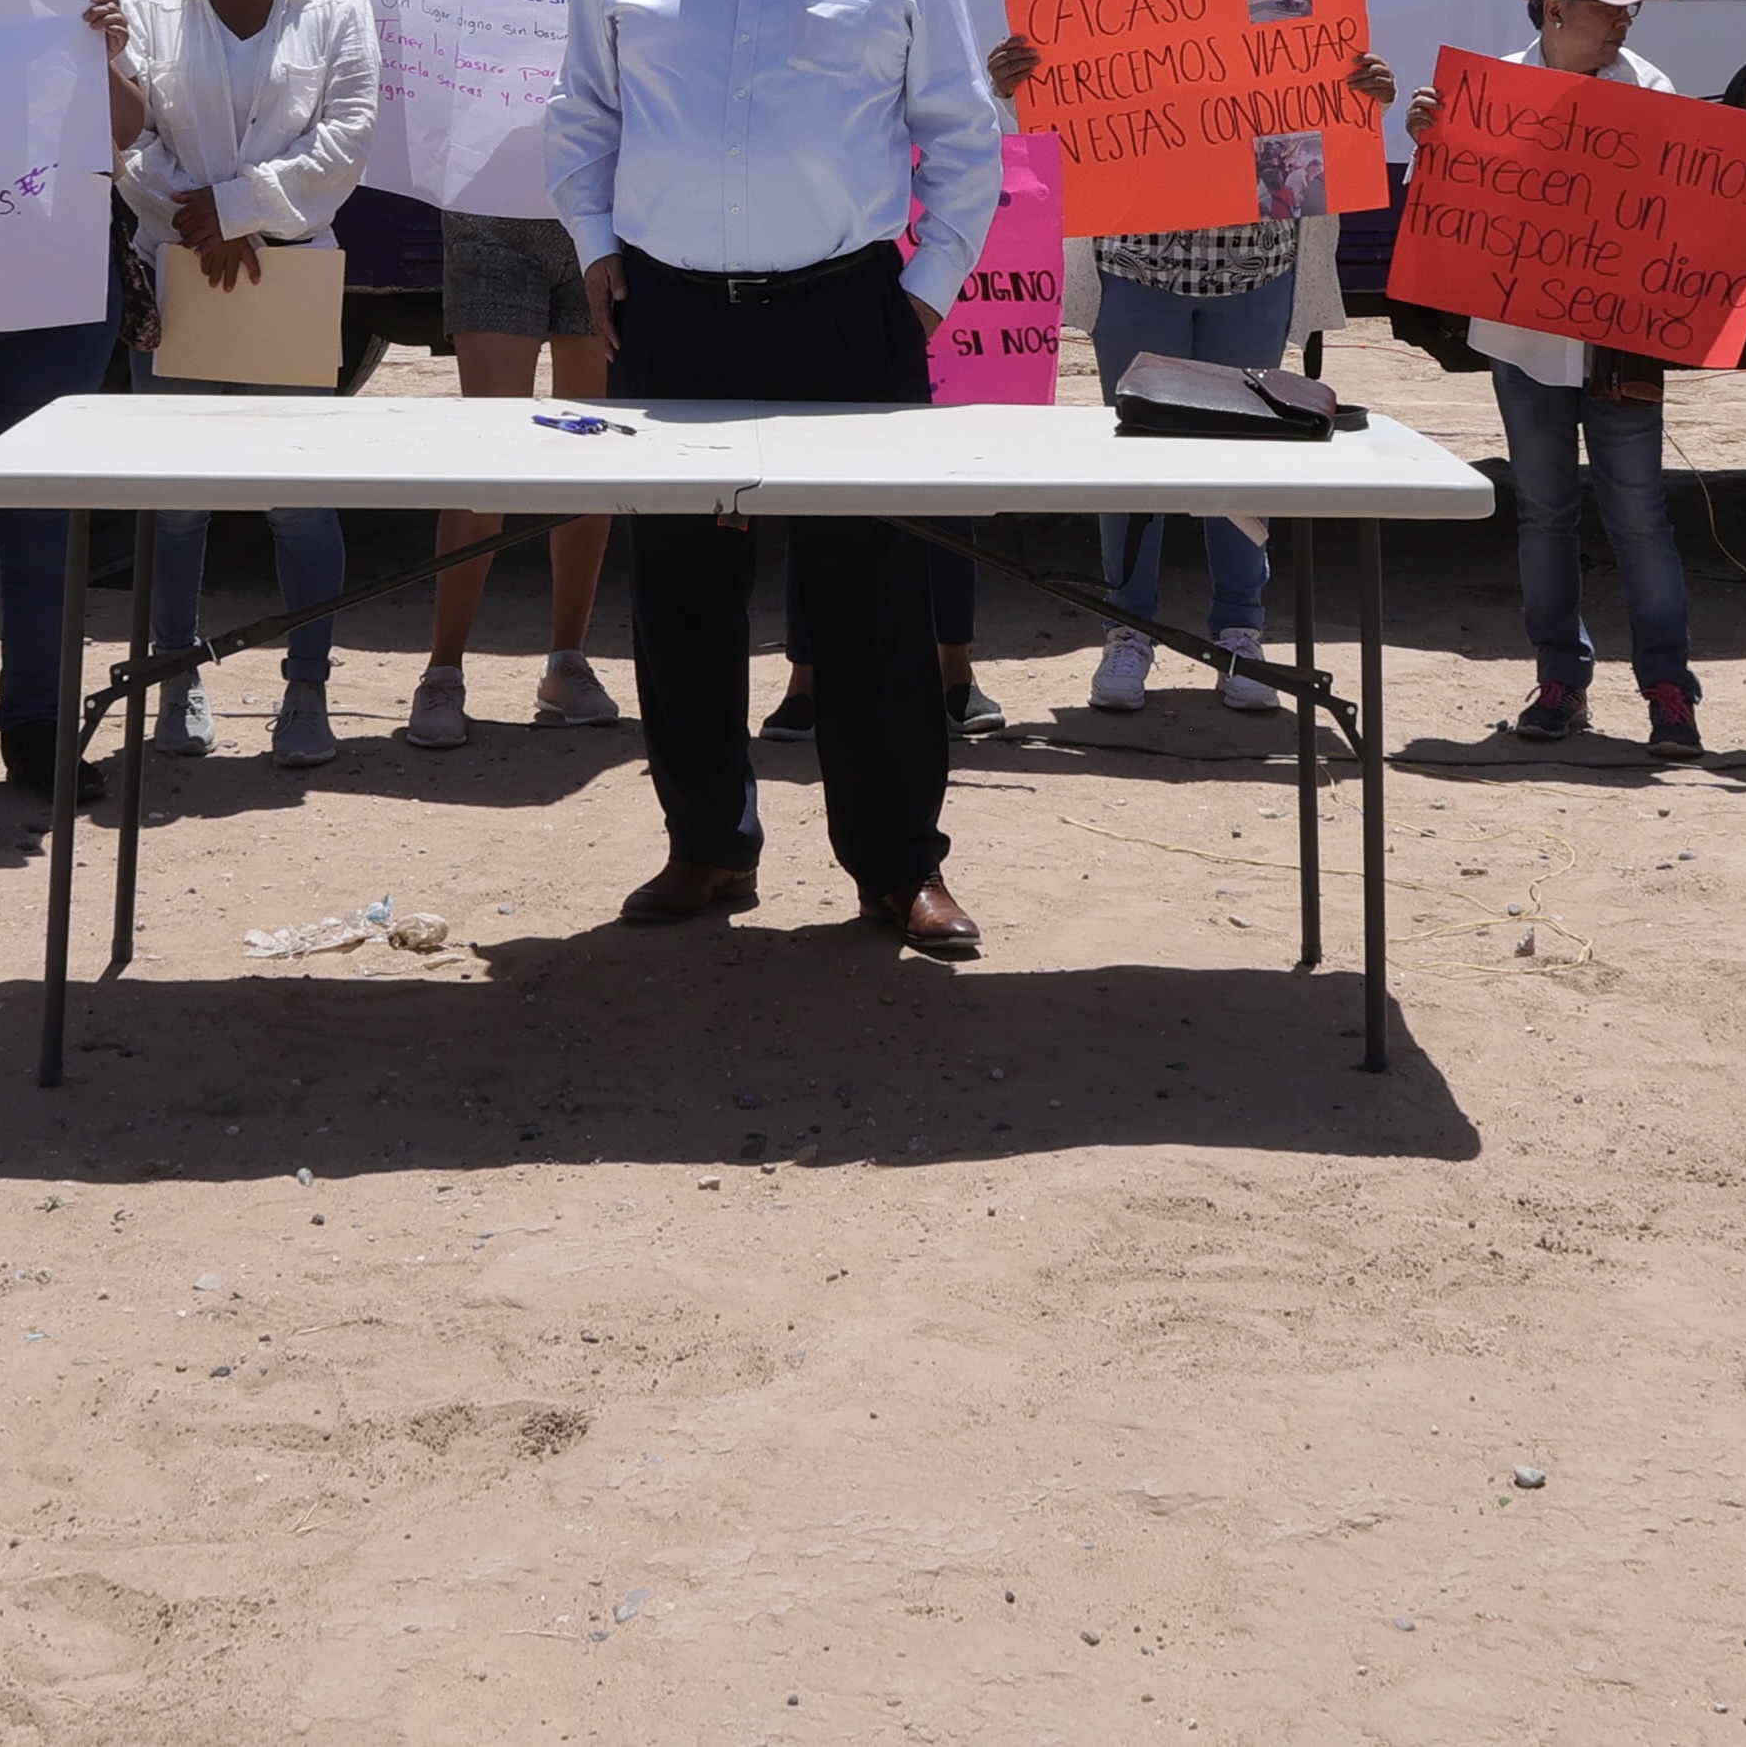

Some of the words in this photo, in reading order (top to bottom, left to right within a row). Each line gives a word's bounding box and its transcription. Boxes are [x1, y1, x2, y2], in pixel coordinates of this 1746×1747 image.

[434, 32, 444, 56] lo
[457, 5, 493, 35] digno
[1028, 35, 1228, 108] MERECEMOS
[1244, 16, 1363, 78] VIAJAR
[1085, 103, 1188, 160] ESTAS
[1450, 69, 1641, 170] Nuestros
[1415, 141, 1592, 215] merecen
[1616, 188, 1667, 240] un
[1408, 183, 1623, 277] transporte
[951, 328, 984, 356] SI
[1000, 324, 1059, 356] NOS
